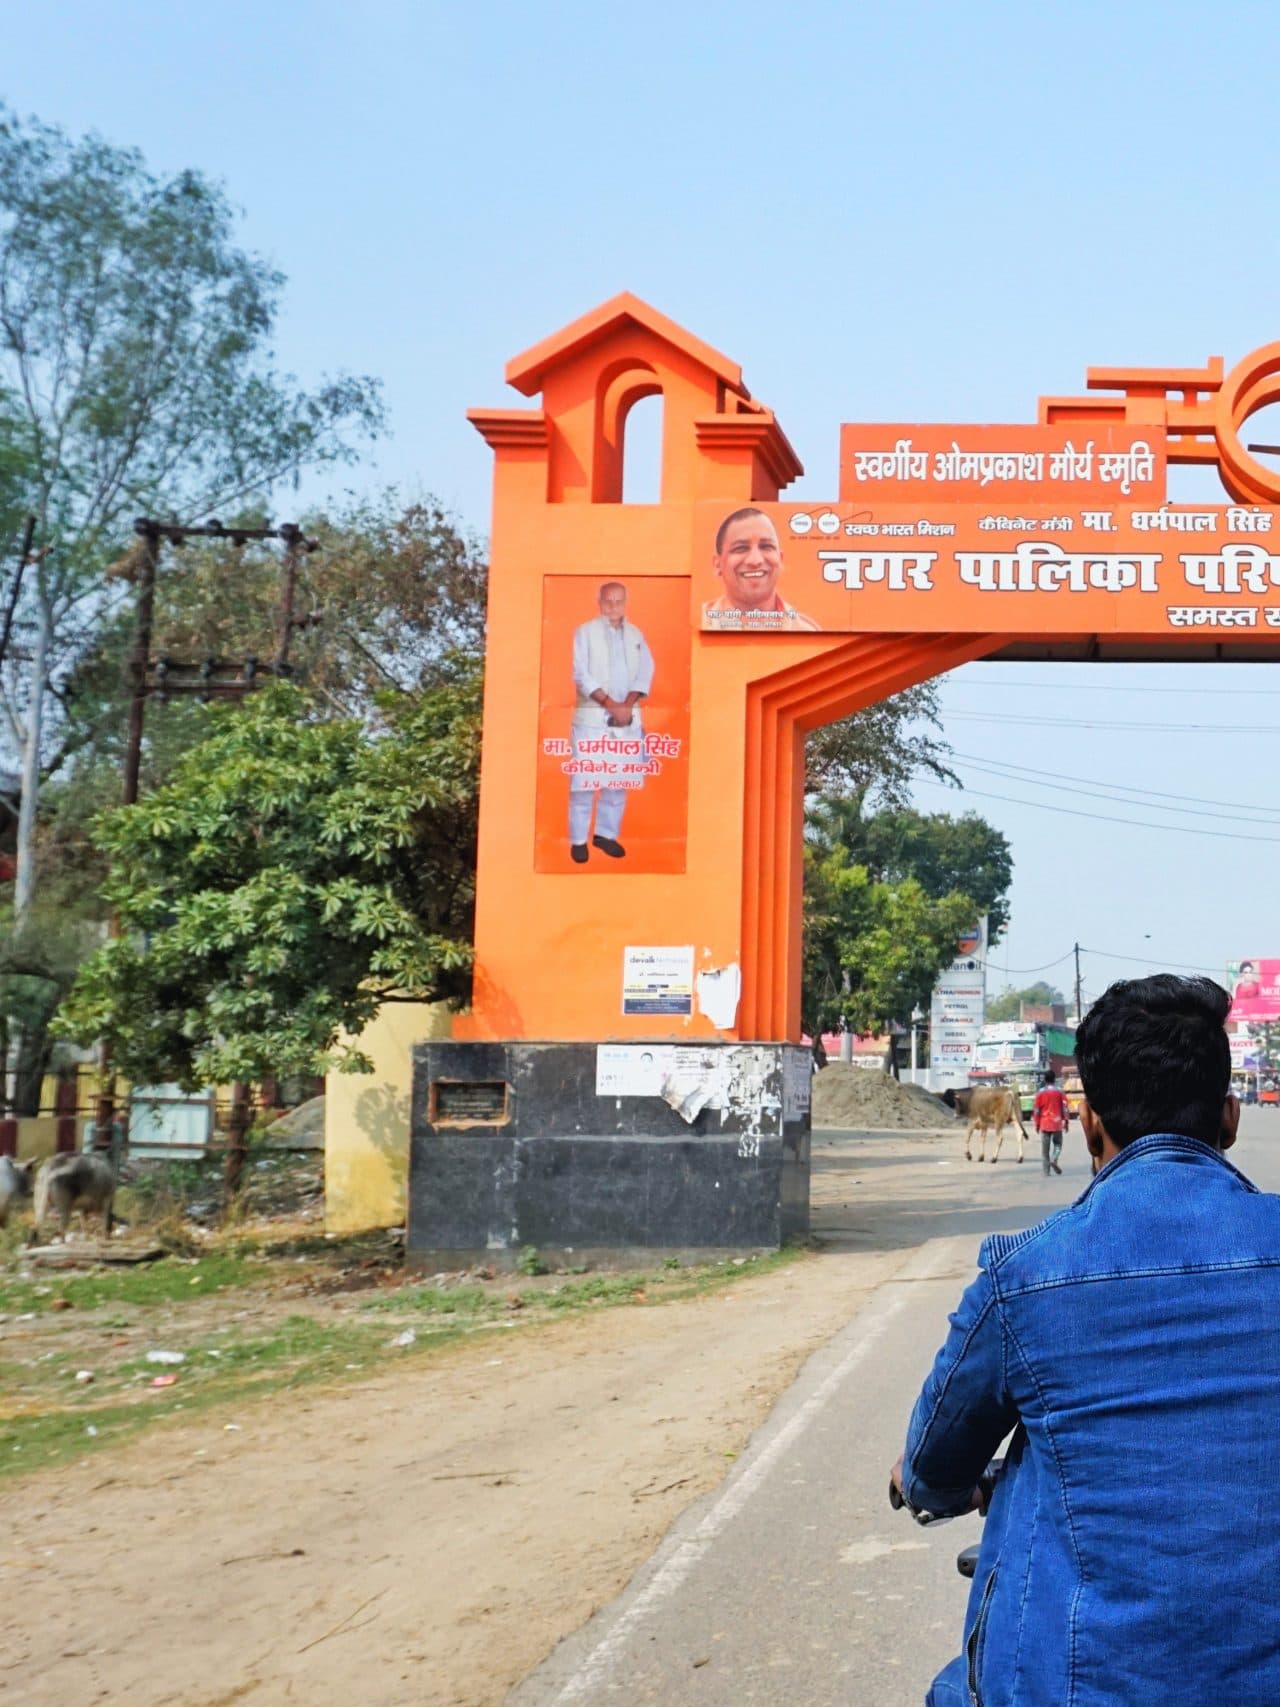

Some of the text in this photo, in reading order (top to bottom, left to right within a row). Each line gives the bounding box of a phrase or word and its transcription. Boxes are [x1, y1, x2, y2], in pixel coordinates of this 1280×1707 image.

[854, 440, 1156, 494] स्वर्गीय ओमप्रकाश मौर्य स्मृति
[882, 523, 914, 536] भारत
[916, 519, 956, 536] मिशन
[1081, 511, 1118, 532] मा.
[1130, 506, 1219, 532] धर्मपाल
[1225, 506, 1273, 533] सिंह
[816, 550, 940, 591] नगर
[954, 541, 1164, 593] पालिका
[1166, 606, 1259, 627] समस्त
[544, 733, 680, 756] मा. धर्मपाल सिंह
